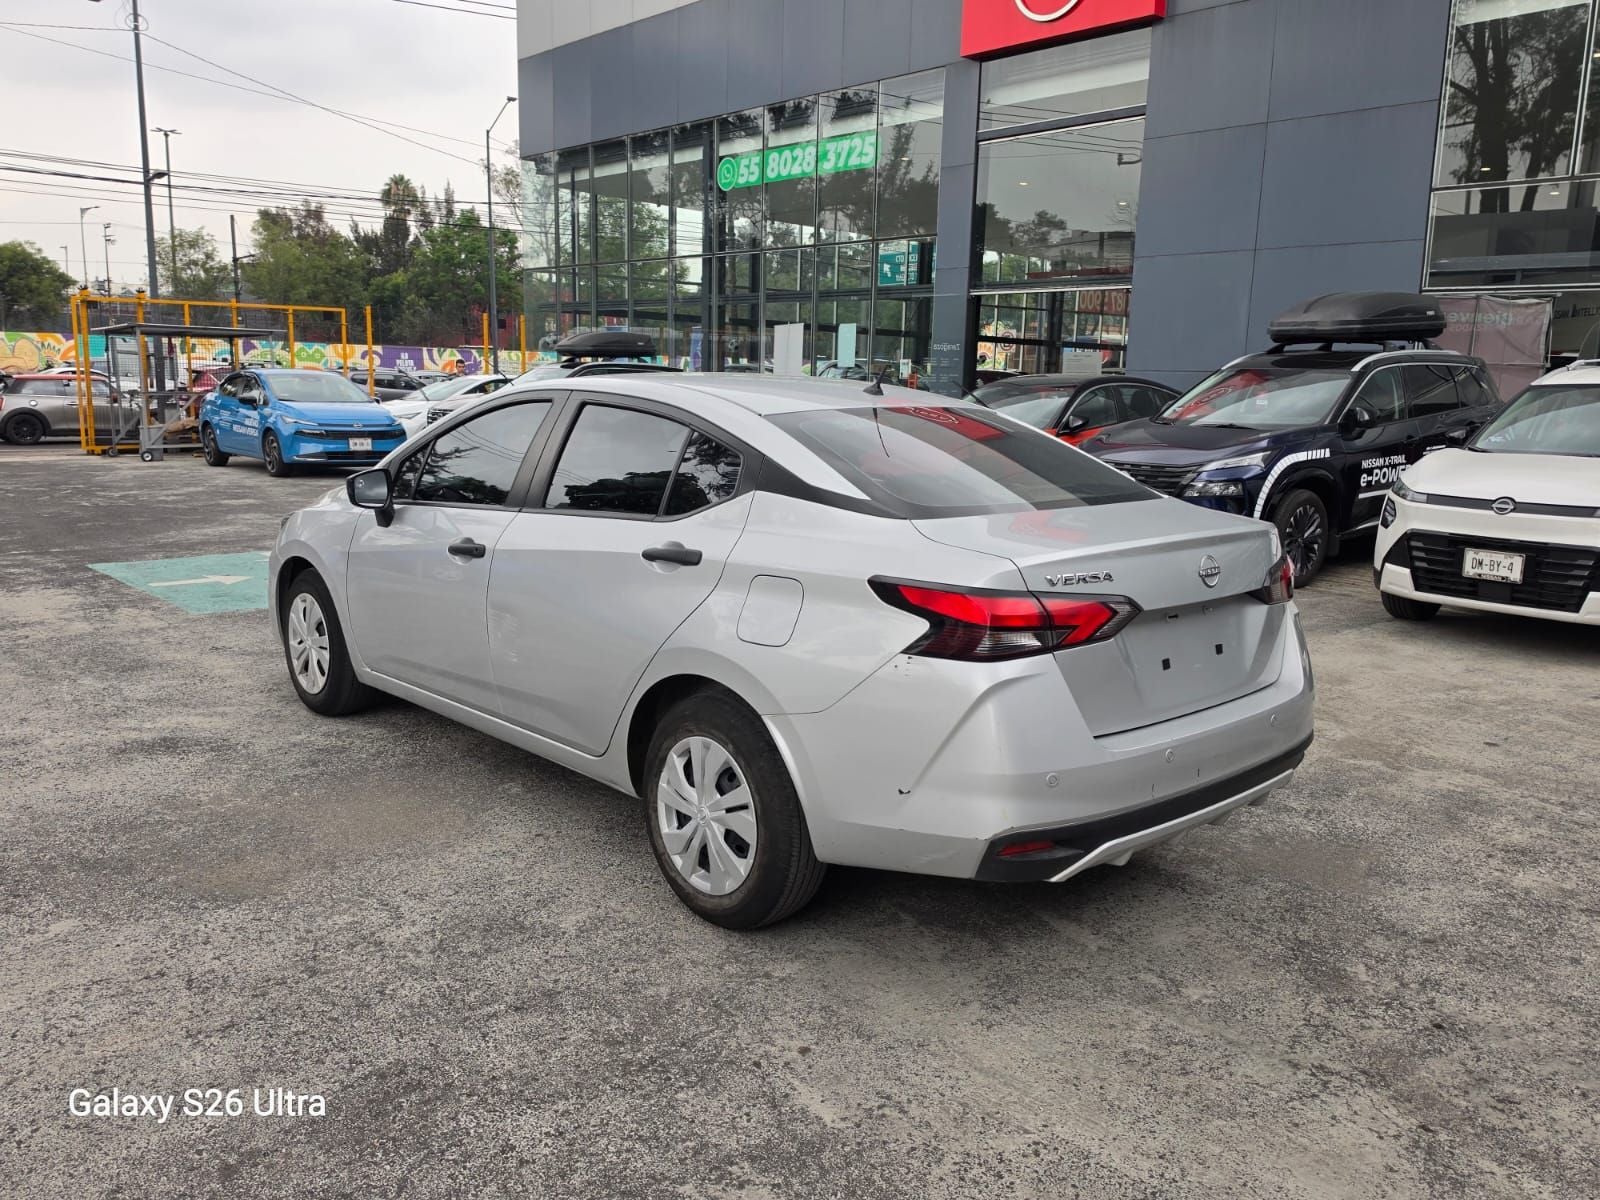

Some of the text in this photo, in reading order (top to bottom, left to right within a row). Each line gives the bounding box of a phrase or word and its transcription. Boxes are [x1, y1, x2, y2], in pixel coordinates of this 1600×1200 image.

[737, 134, 877, 184] 55 8028 3725
[1361, 454, 1407, 469] NISSAN X-TRAIL
[1471, 556, 1515, 574] DM-BY-4
[1044, 570, 1115, 587] VERSA
